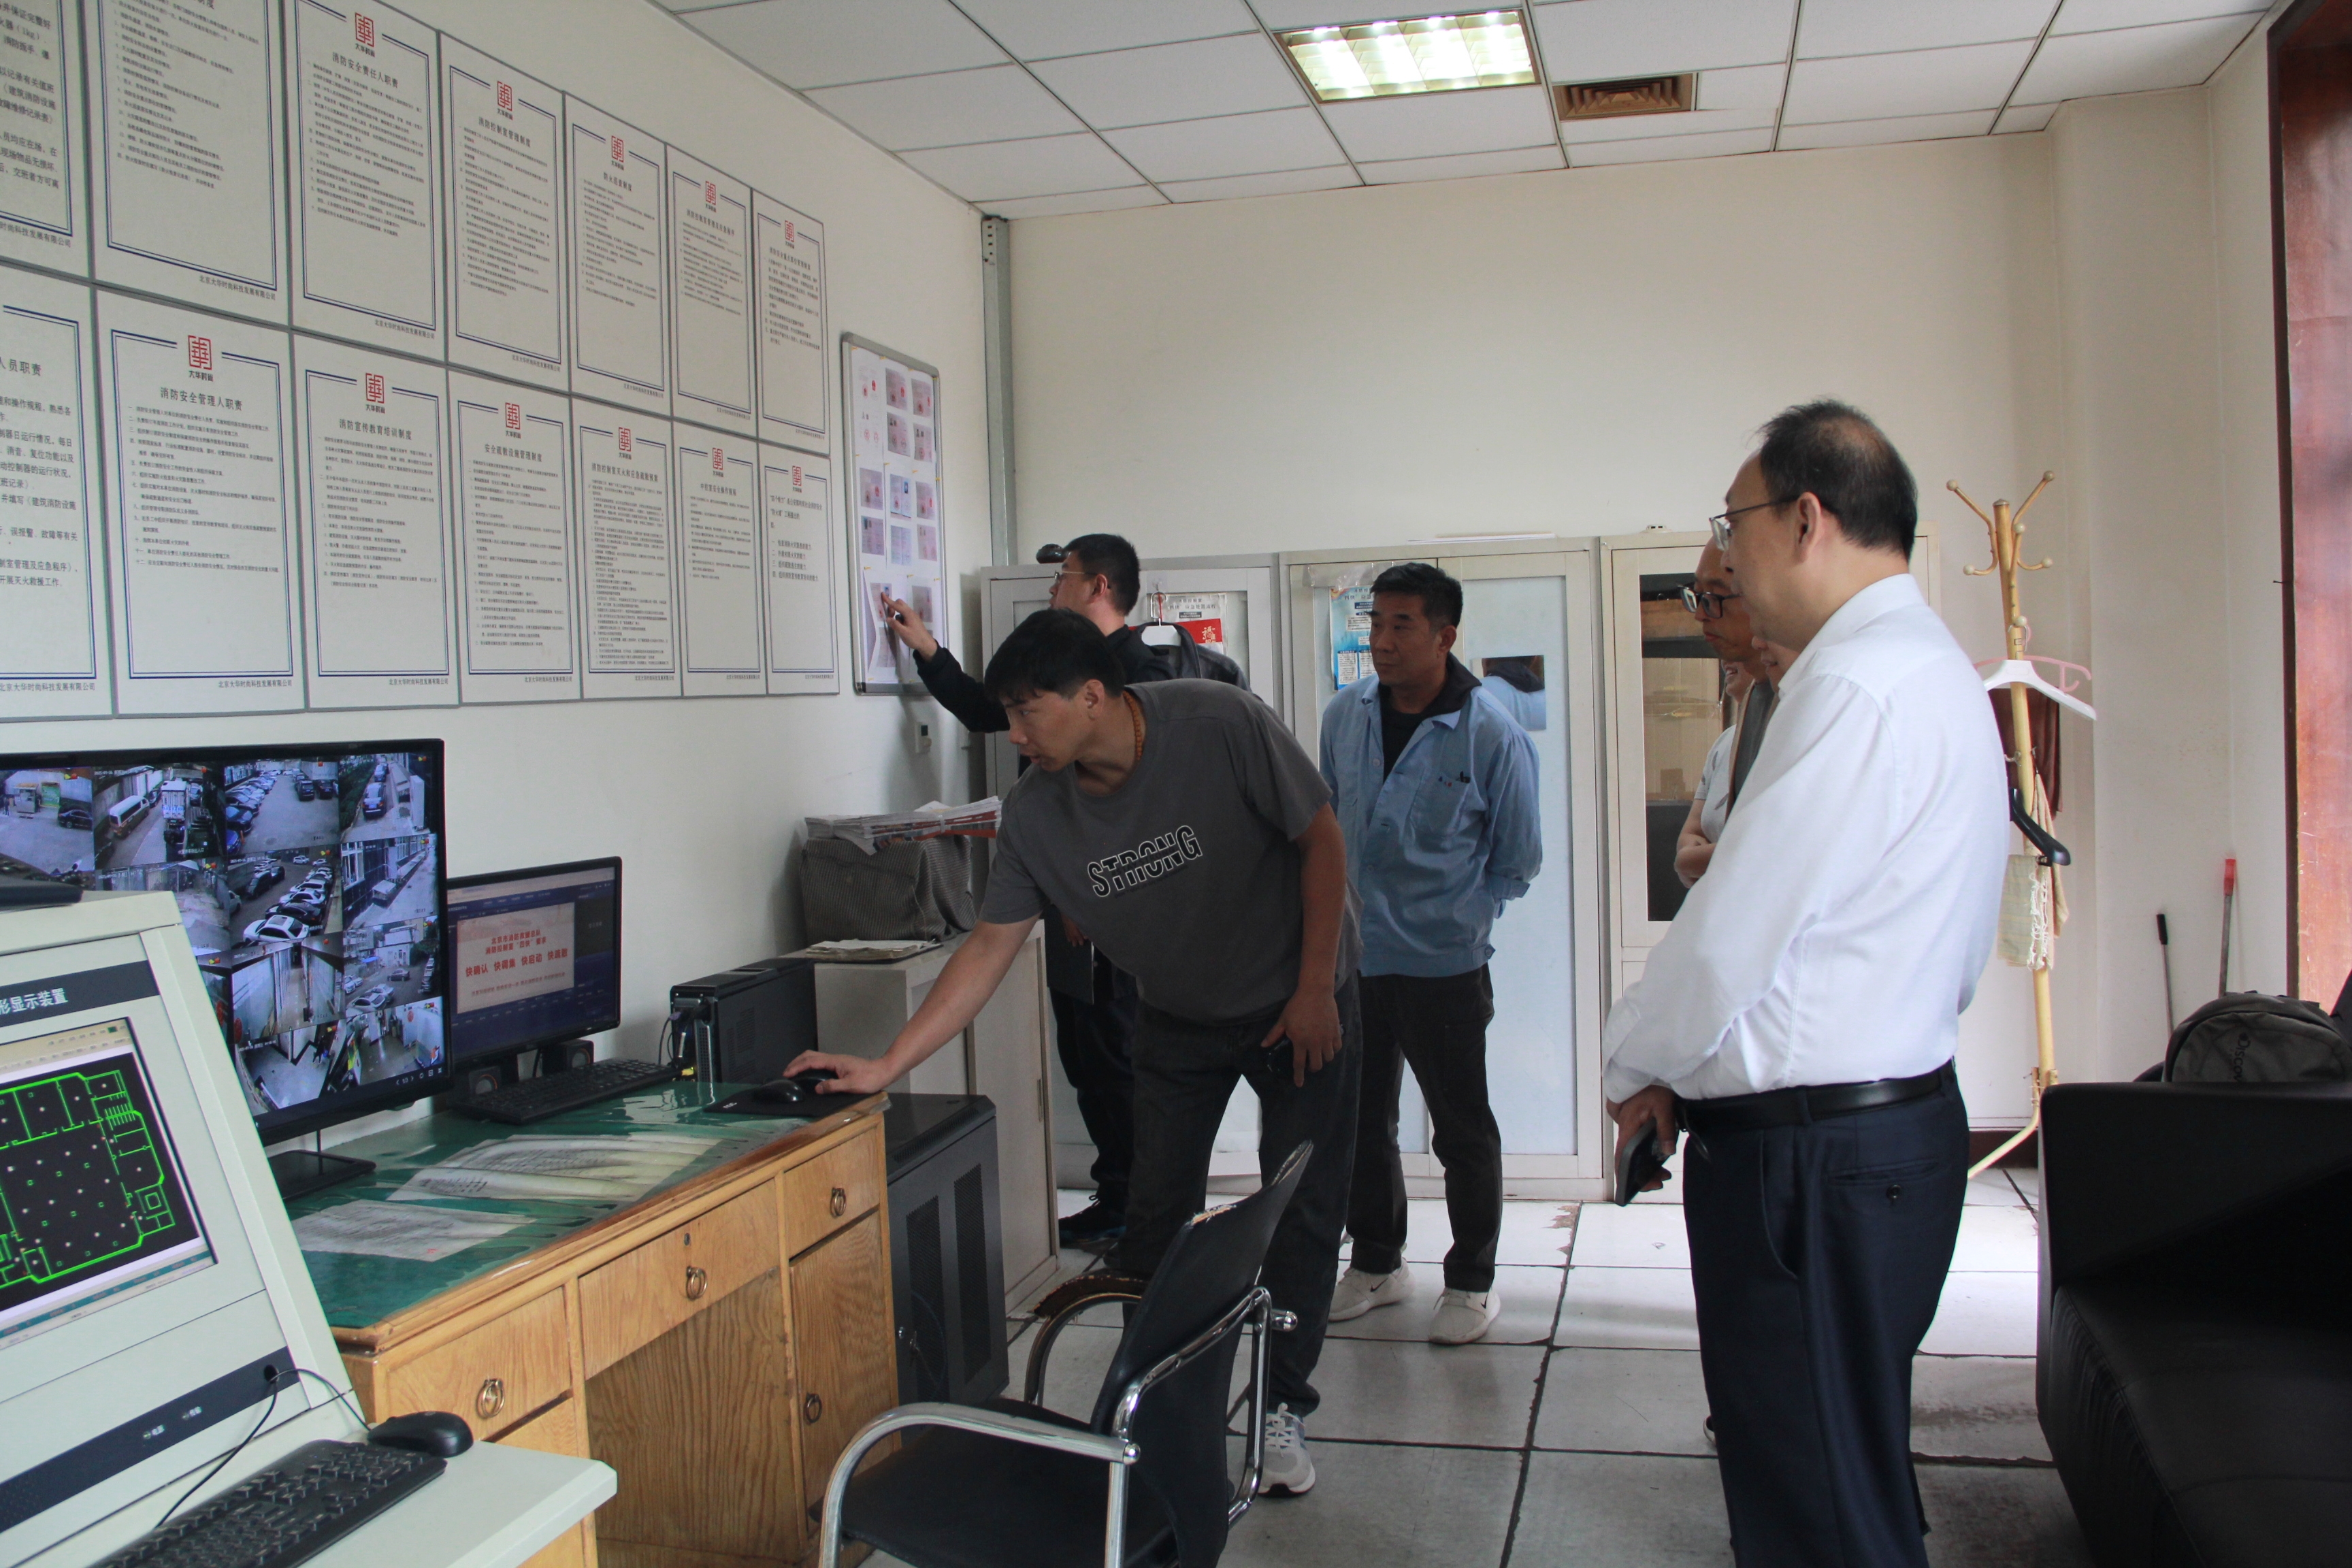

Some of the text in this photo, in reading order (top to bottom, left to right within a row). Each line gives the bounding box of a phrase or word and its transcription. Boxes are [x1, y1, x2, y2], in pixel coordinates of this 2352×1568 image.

[332, 51, 398, 88] 消防安全责任人职责
[478, 116, 530, 148] 消防控制室管理制度
[160, 387, 242, 411] 消防安全管理人职责
[340, 419, 412, 440] 消防宣传教育培训制度
[485, 444, 542, 462] 安全疏散设施管理制度
[1087, 825, 1203, 898] STRONG
[491, 929, 540, 945] 北京市消防救援总队
[466, 948, 568, 977] 快确认 快调集 快启动 快疏散
